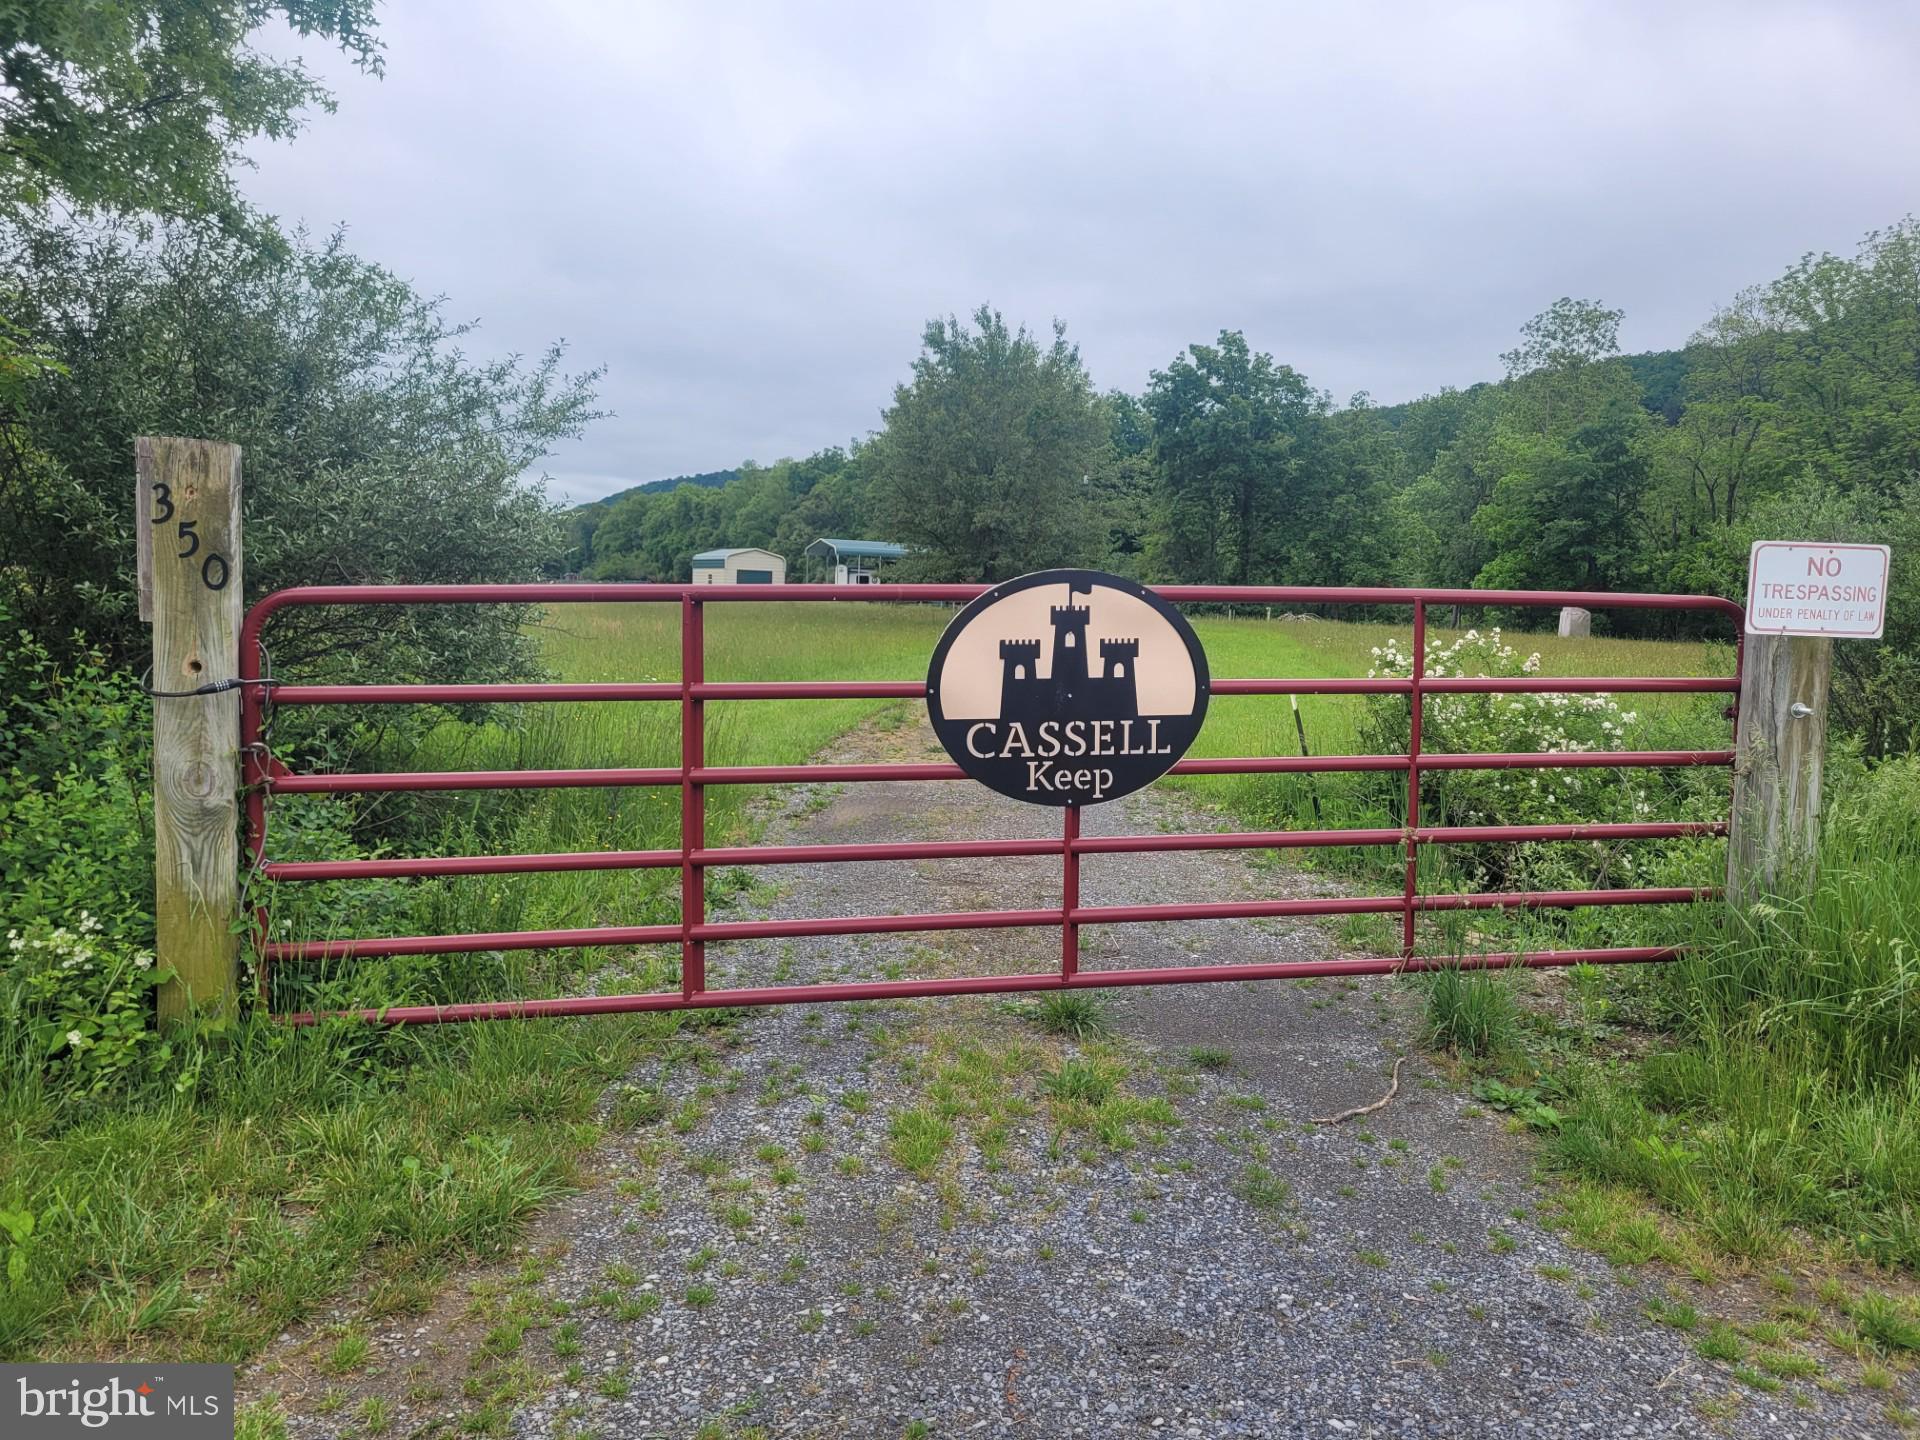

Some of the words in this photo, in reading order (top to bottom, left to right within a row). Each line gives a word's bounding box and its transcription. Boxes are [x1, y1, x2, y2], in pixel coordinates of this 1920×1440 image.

[1807, 556, 1842, 577] NO
[1761, 583, 1877, 603] TRESPASSING
[1758, 607, 1793, 619] UNDER
[1797, 608, 1840, 621] PENALTY
[1843, 609, 1855, 621] OF
[1858, 610, 1875, 622] LAW
[966, 719, 1171, 759] CASSELL
[1026, 761, 1113, 798] Keep
